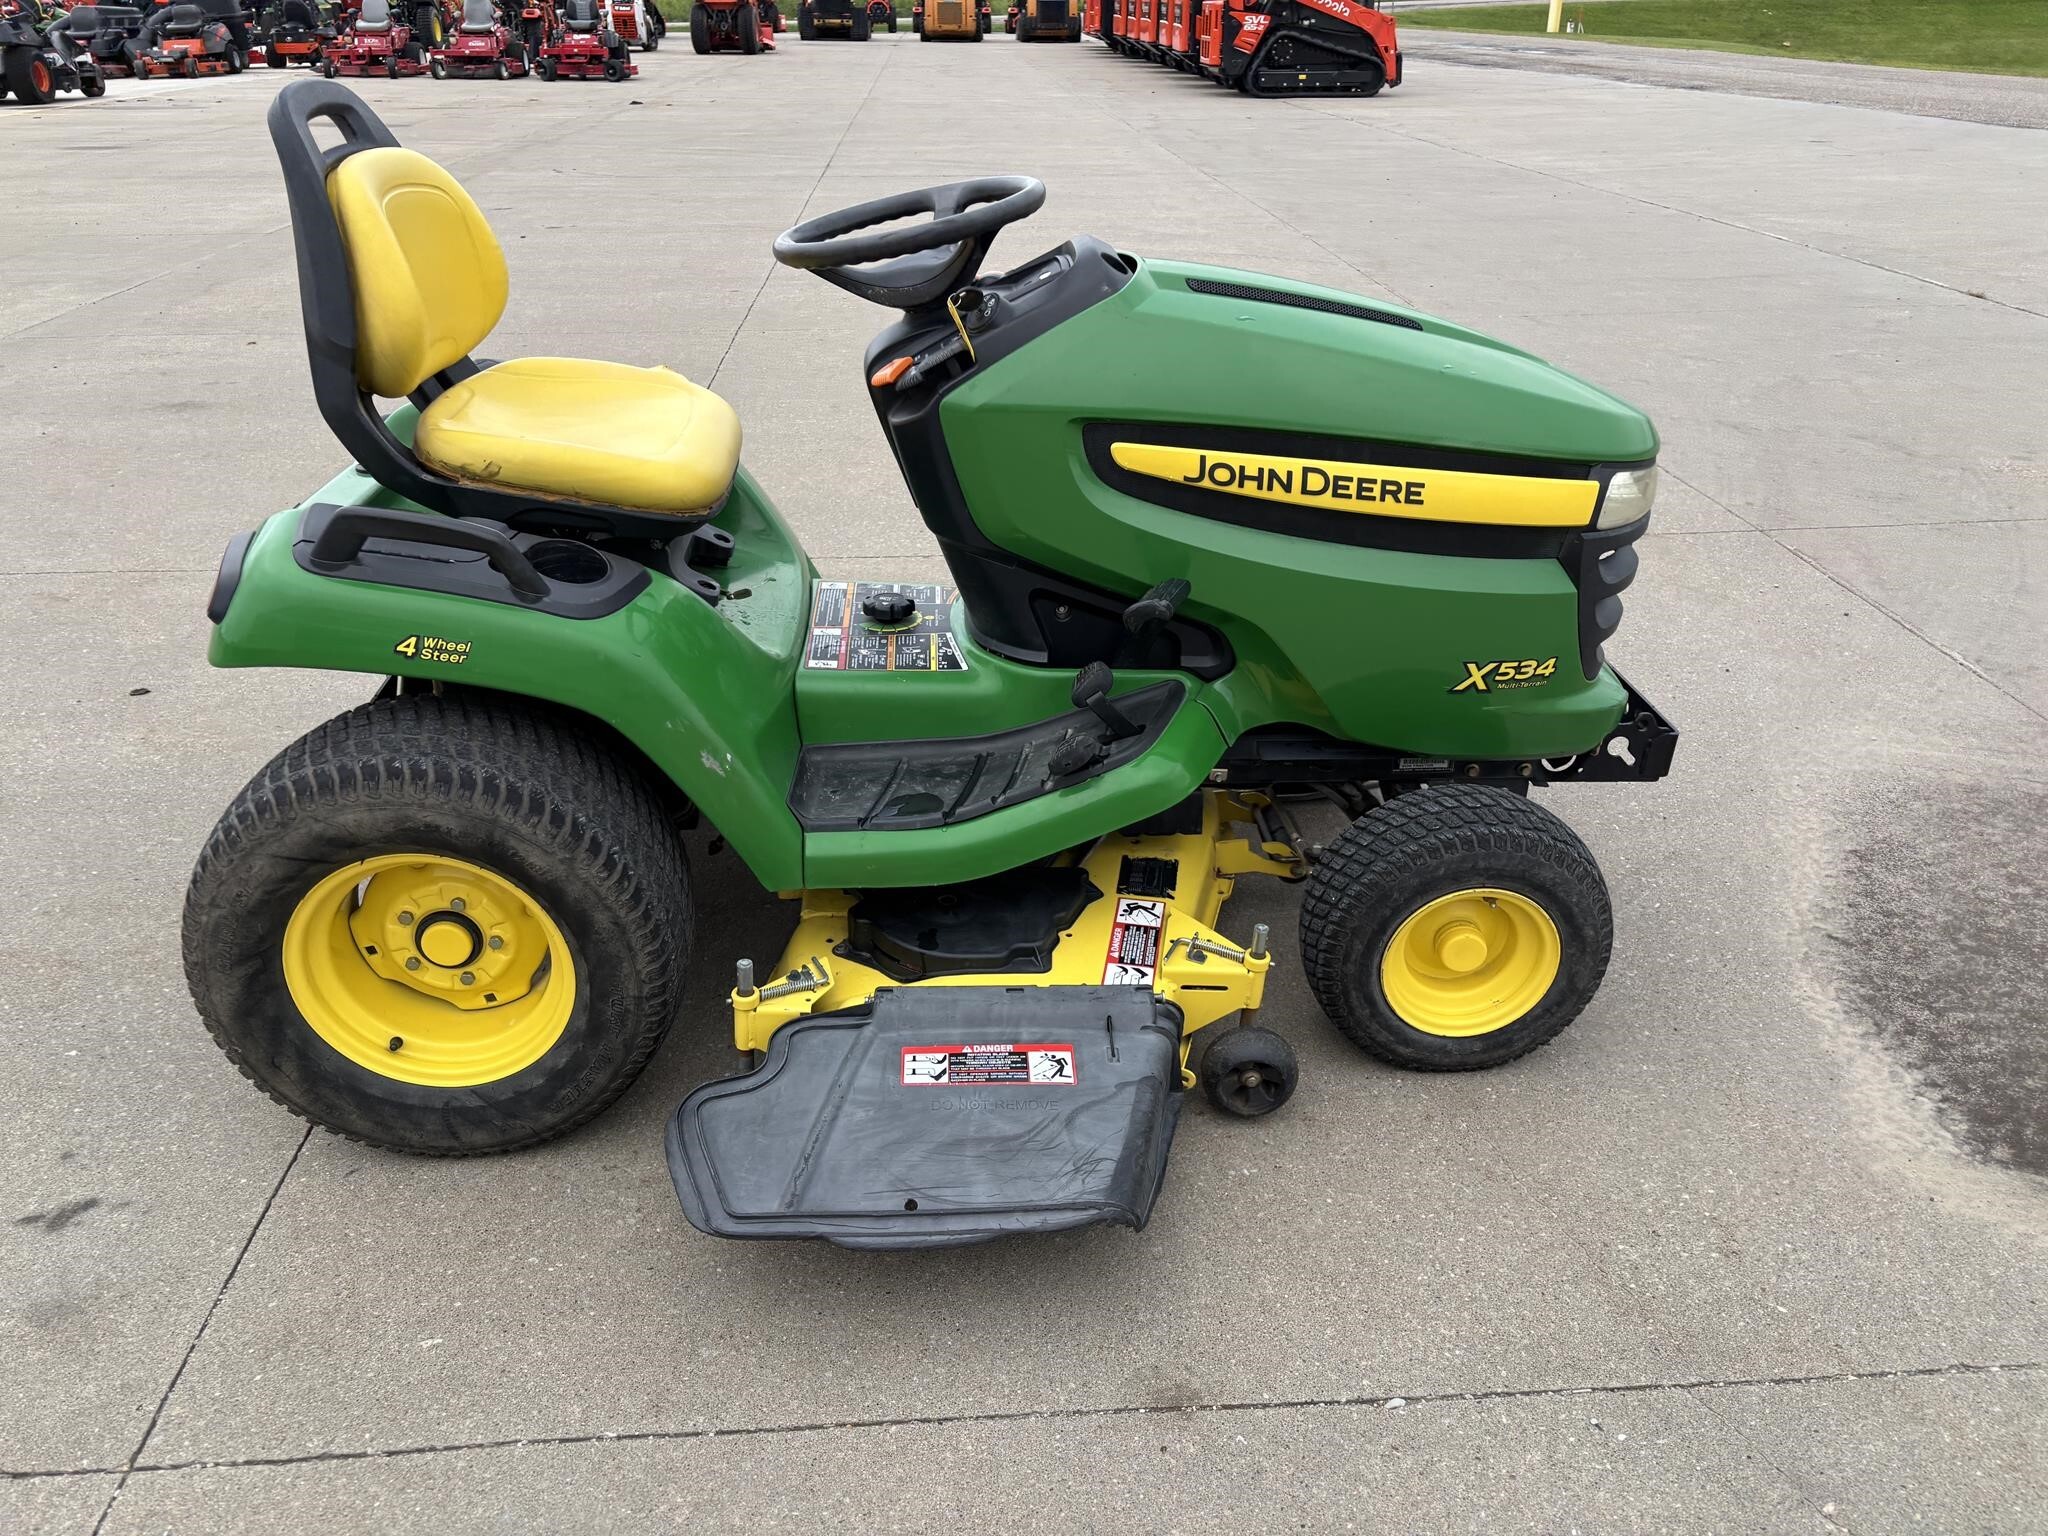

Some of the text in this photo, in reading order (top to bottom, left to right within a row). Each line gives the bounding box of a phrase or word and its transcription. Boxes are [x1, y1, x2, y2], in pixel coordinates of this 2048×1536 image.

[1243, 15, 1269, 24] SVL
[1184, 455, 1425, 506] JOHN DEERE
[396, 636, 472, 657] 4 Wheel
[420, 648, 467, 663] Steer
[1450, 657, 1557, 692] X534
[1497, 680, 1547, 689] Multi-Terrain
[1112, 928, 1122, 952] DANGER
[973, 1044, 1014, 1052] DANGER
[930, 1099, 1059, 1112] DO NOT REMOVE
